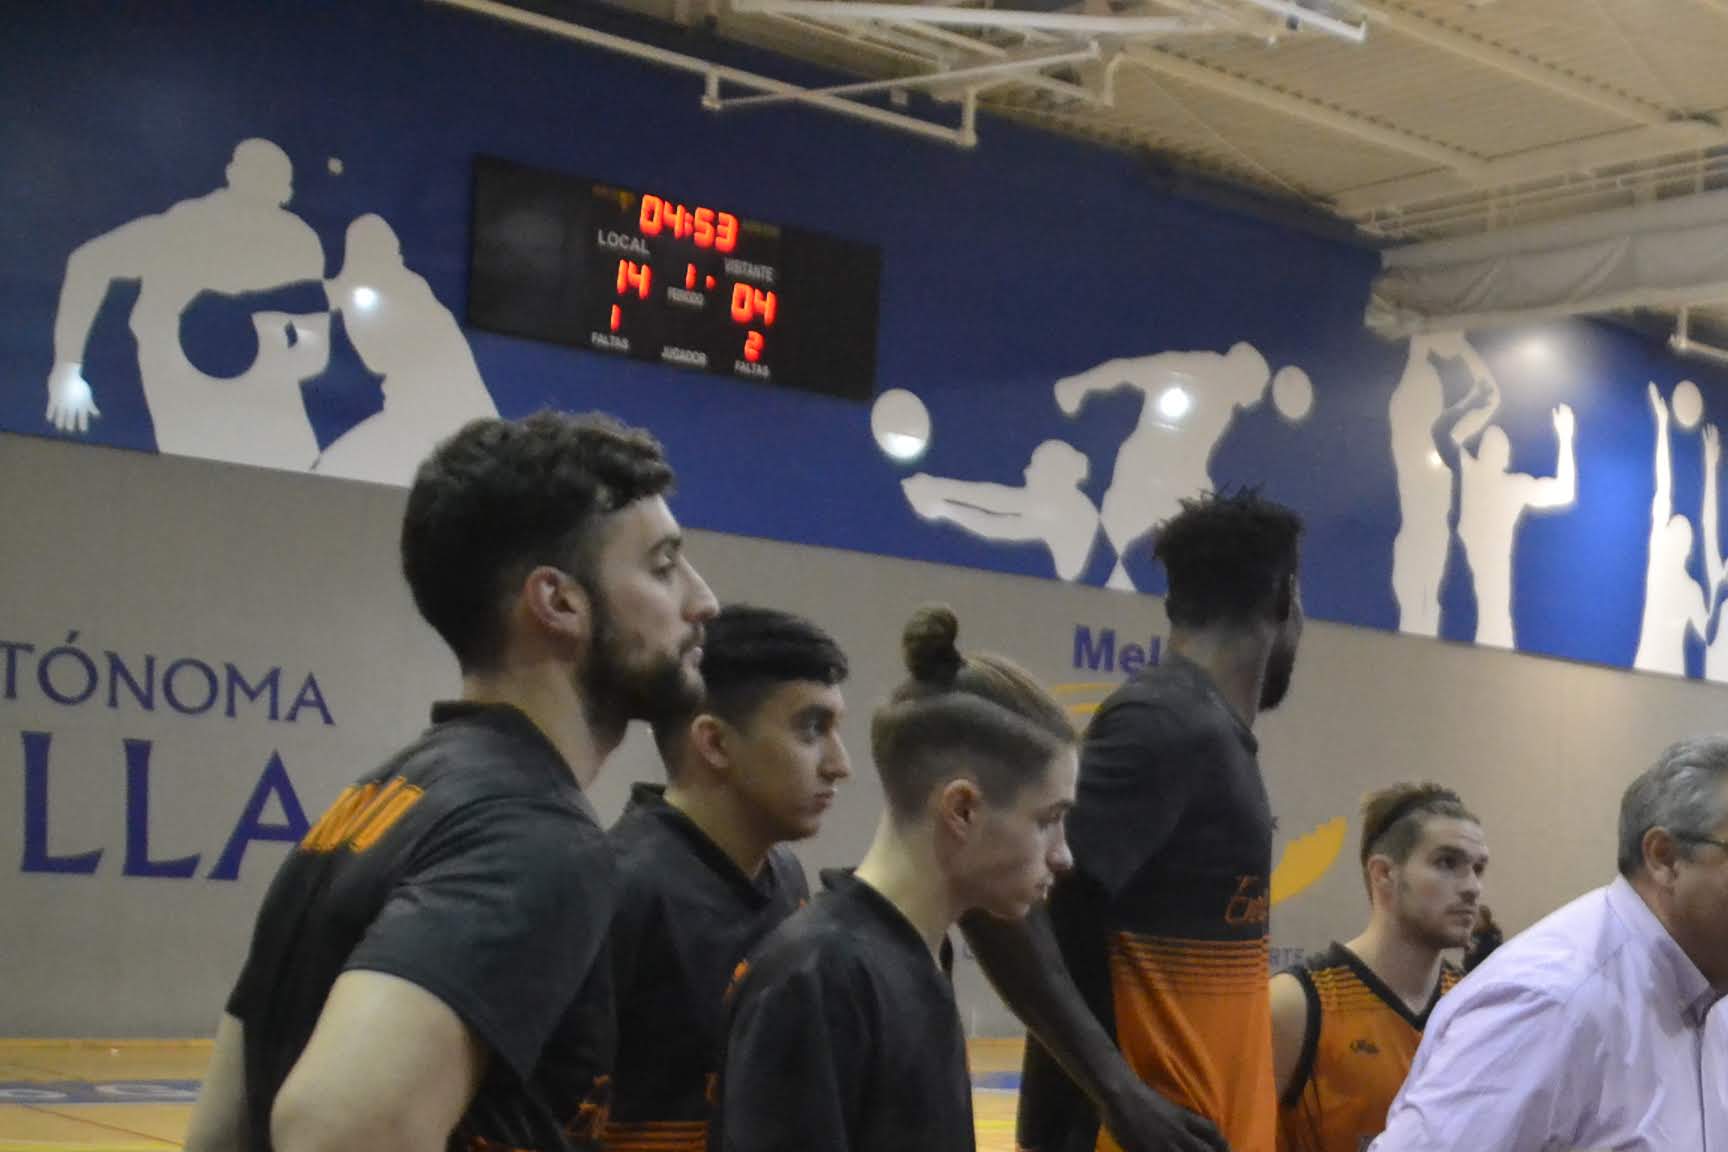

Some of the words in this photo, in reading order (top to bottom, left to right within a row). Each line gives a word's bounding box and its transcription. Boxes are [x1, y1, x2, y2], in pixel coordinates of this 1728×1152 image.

[639, 194, 739, 253] 04:53
[597, 229, 650, 256] LOCAL
[616, 259, 651, 299] 14
[724, 257, 775, 282] VISITANTE
[610, 303, 622, 333] 1
[731, 282, 778, 327] 04
[591, 331, 629, 352] FALTAS
[661, 344, 707, 367] JUGADOR
[743, 330, 765, 363] 2
[734, 359, 770, 379] FALTAS
